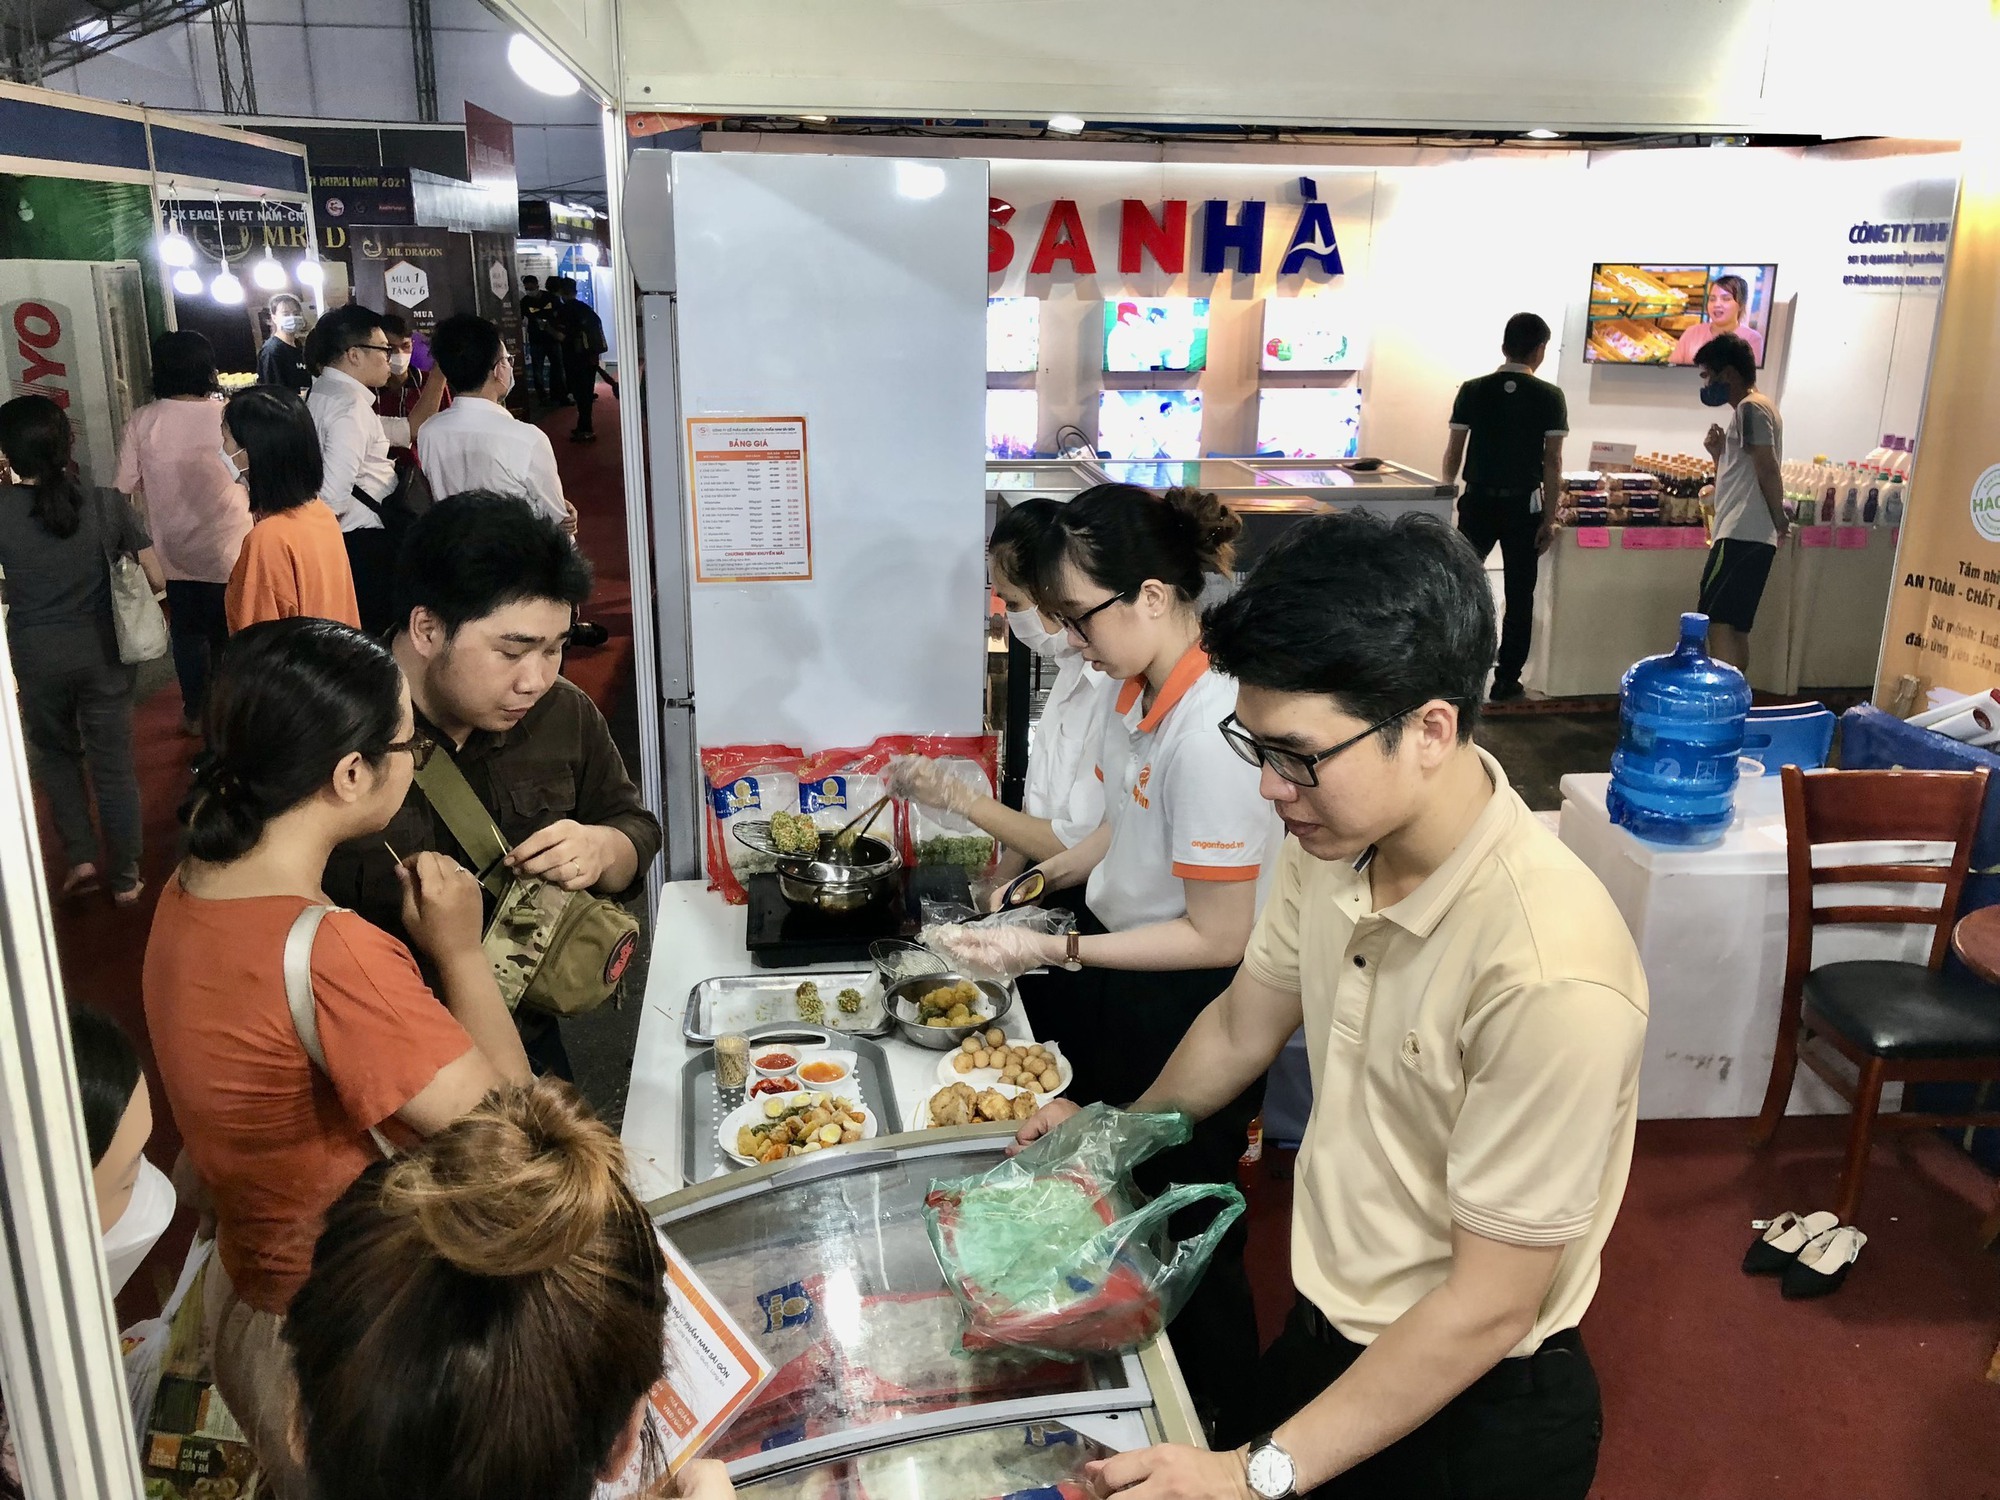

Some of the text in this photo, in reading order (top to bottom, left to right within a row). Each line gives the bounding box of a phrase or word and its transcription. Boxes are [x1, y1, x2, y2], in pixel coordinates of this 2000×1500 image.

[190, 209, 225, 221] EAGLE
[228, 208, 253, 223] VIỆT
[404, 247, 443, 257] DRAGON
[391, 272, 420, 283] MUA 1
[419, 286, 426, 295] 6
[413, 310, 434, 318] MUA
[729, 438, 769, 448] BẢNG GIÁ
[1904, 573, 1925, 588] AN
[1928, 575, 1956, 597] TOÀN
[1966, 587, 1995, 609] CHẤT
[1905, 632, 1927, 650] đáp
[697, 1338, 711, 1355] NAM
[716, 1362, 731, 1379] GÒN
